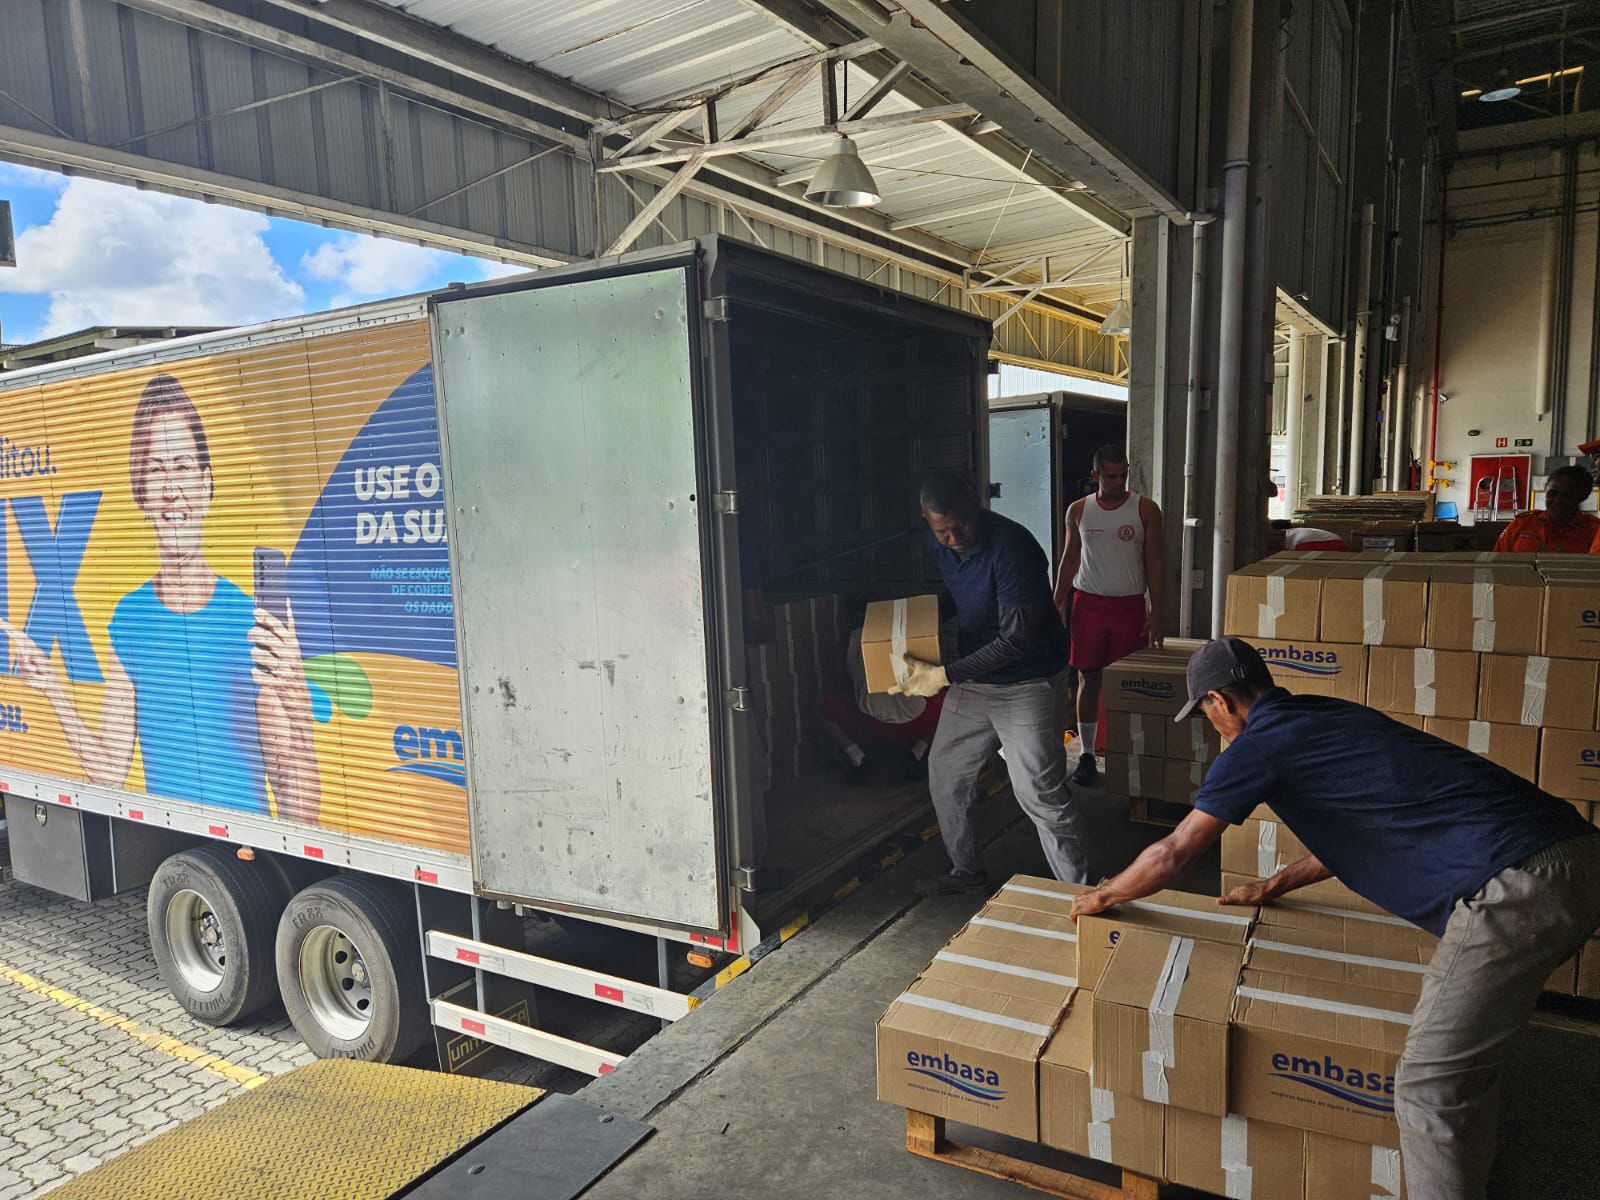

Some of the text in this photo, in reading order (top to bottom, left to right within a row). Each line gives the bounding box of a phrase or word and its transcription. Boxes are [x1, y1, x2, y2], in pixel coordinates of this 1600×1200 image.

[354, 462, 440, 501] USE O
[355, 509, 449, 544] DA SU
[370, 564, 394, 580] NÃO
[391, 584, 405, 596] DE
[404, 601, 420, 613] OS
[1257, 645, 1337, 663] embasa
[1121, 677, 1174, 691] embasa
[907, 1051, 999, 1087] embasa
